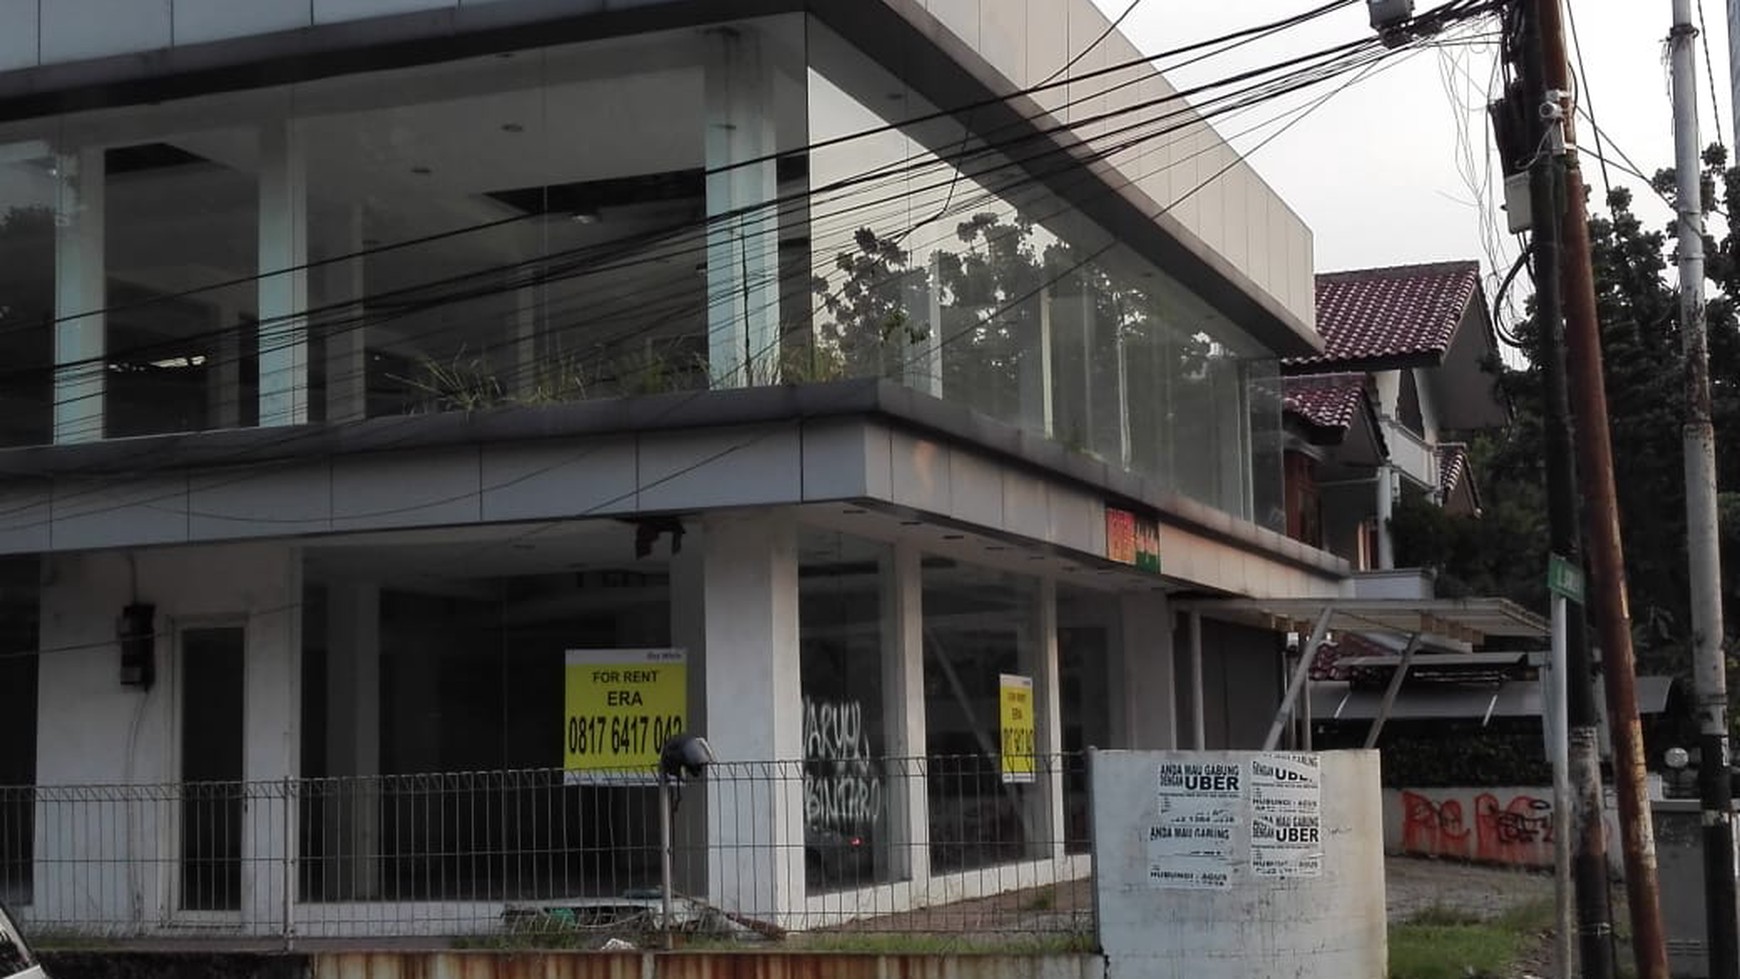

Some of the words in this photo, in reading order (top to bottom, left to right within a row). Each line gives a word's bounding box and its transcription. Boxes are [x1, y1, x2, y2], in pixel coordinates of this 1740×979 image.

[592, 671, 619, 683] FOR
[623, 670, 658, 683] RENT
[607, 690, 643, 706] ERA
[569, 716, 606, 755] 0817
[612, 716, 648, 755] 6417
[1160, 765, 1182, 775] ANDA
[1204, 764, 1239, 776] GABUNG
[1185, 776, 1239, 790] UBER
[1276, 827, 1319, 843] UBER
